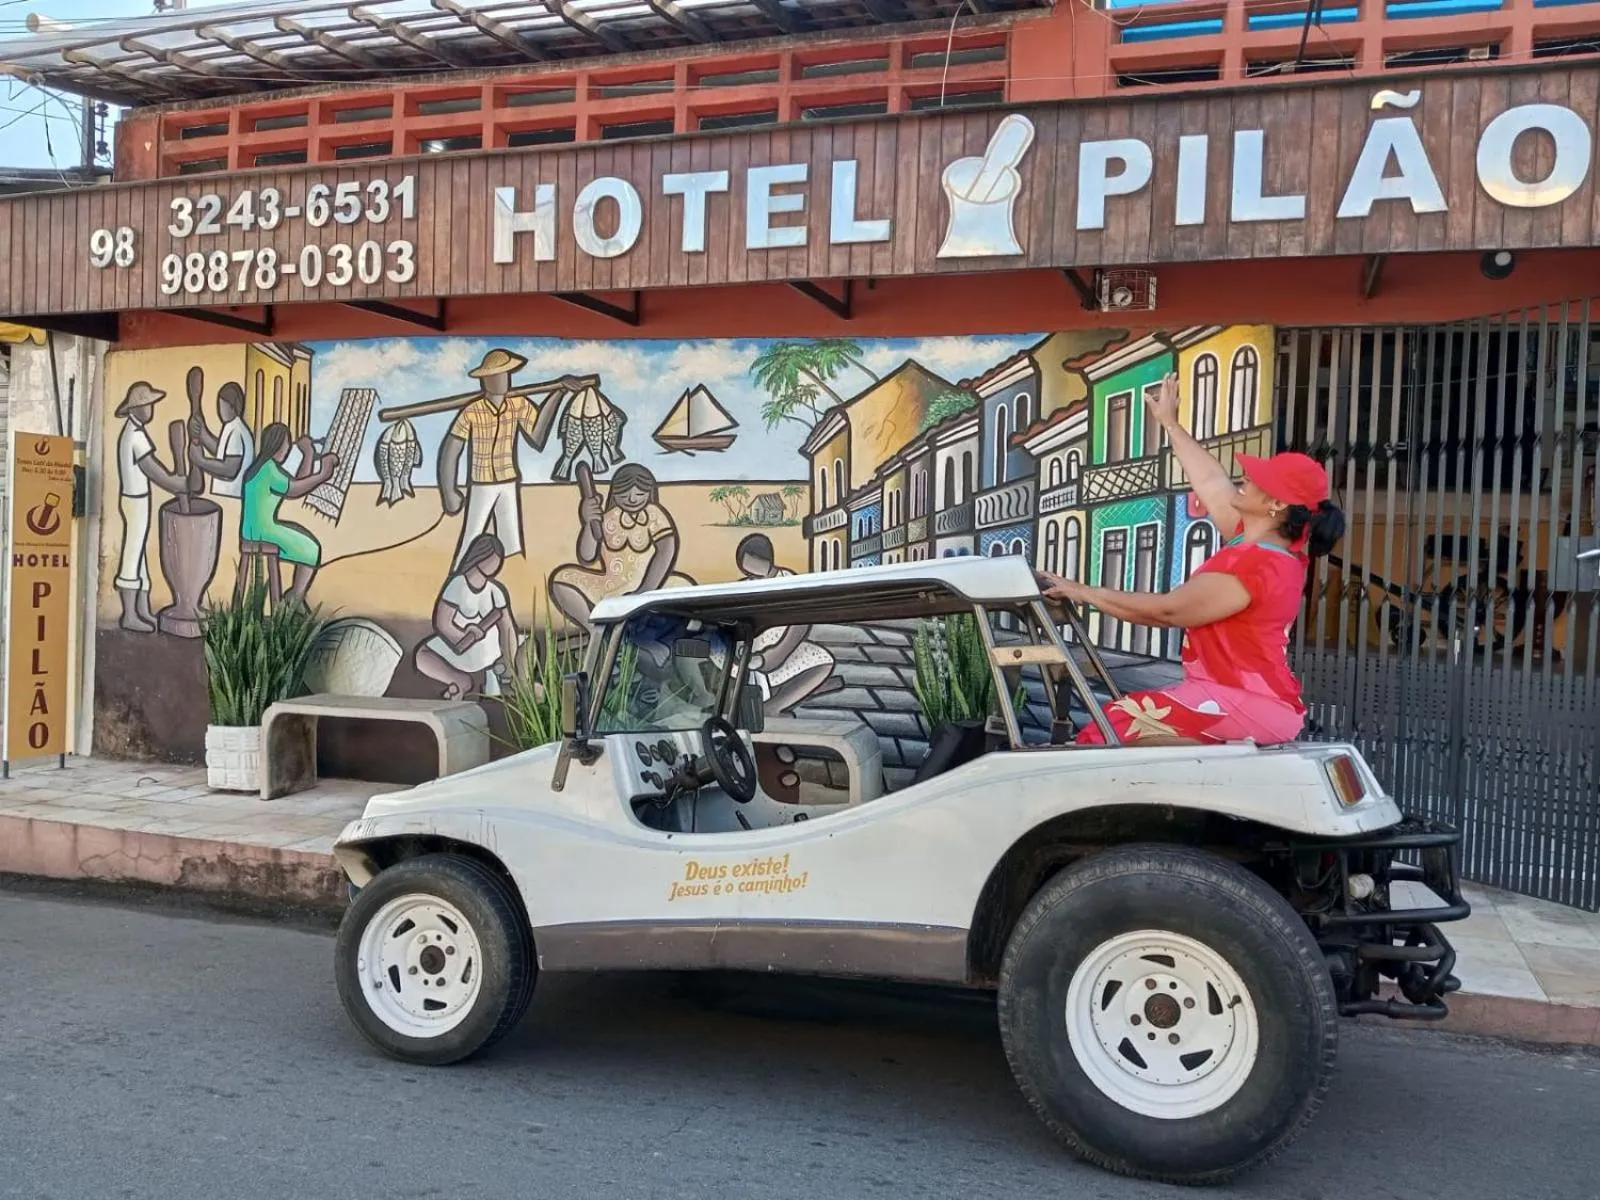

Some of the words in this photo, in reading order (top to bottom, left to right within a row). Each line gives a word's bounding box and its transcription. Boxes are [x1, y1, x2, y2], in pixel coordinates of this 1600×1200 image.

[493, 160, 891, 264] HOTEL
[1076, 89, 1592, 231] PILÃO
[167, 175, 417, 238] 3243-6531
[90, 226, 136, 269] 98
[160, 239, 415, 295] 98878-0303
[13, 553, 70, 568] HOTEL
[28, 581, 52, 750] PILÃO
[668, 881, 709, 902] Jesus
[713, 879, 721, 896] é
[725, 884, 734, 894] o
[738, 871, 809, 895] caminho!
[685, 860, 728, 881] Deus
[732, 852, 791, 879] existe!
